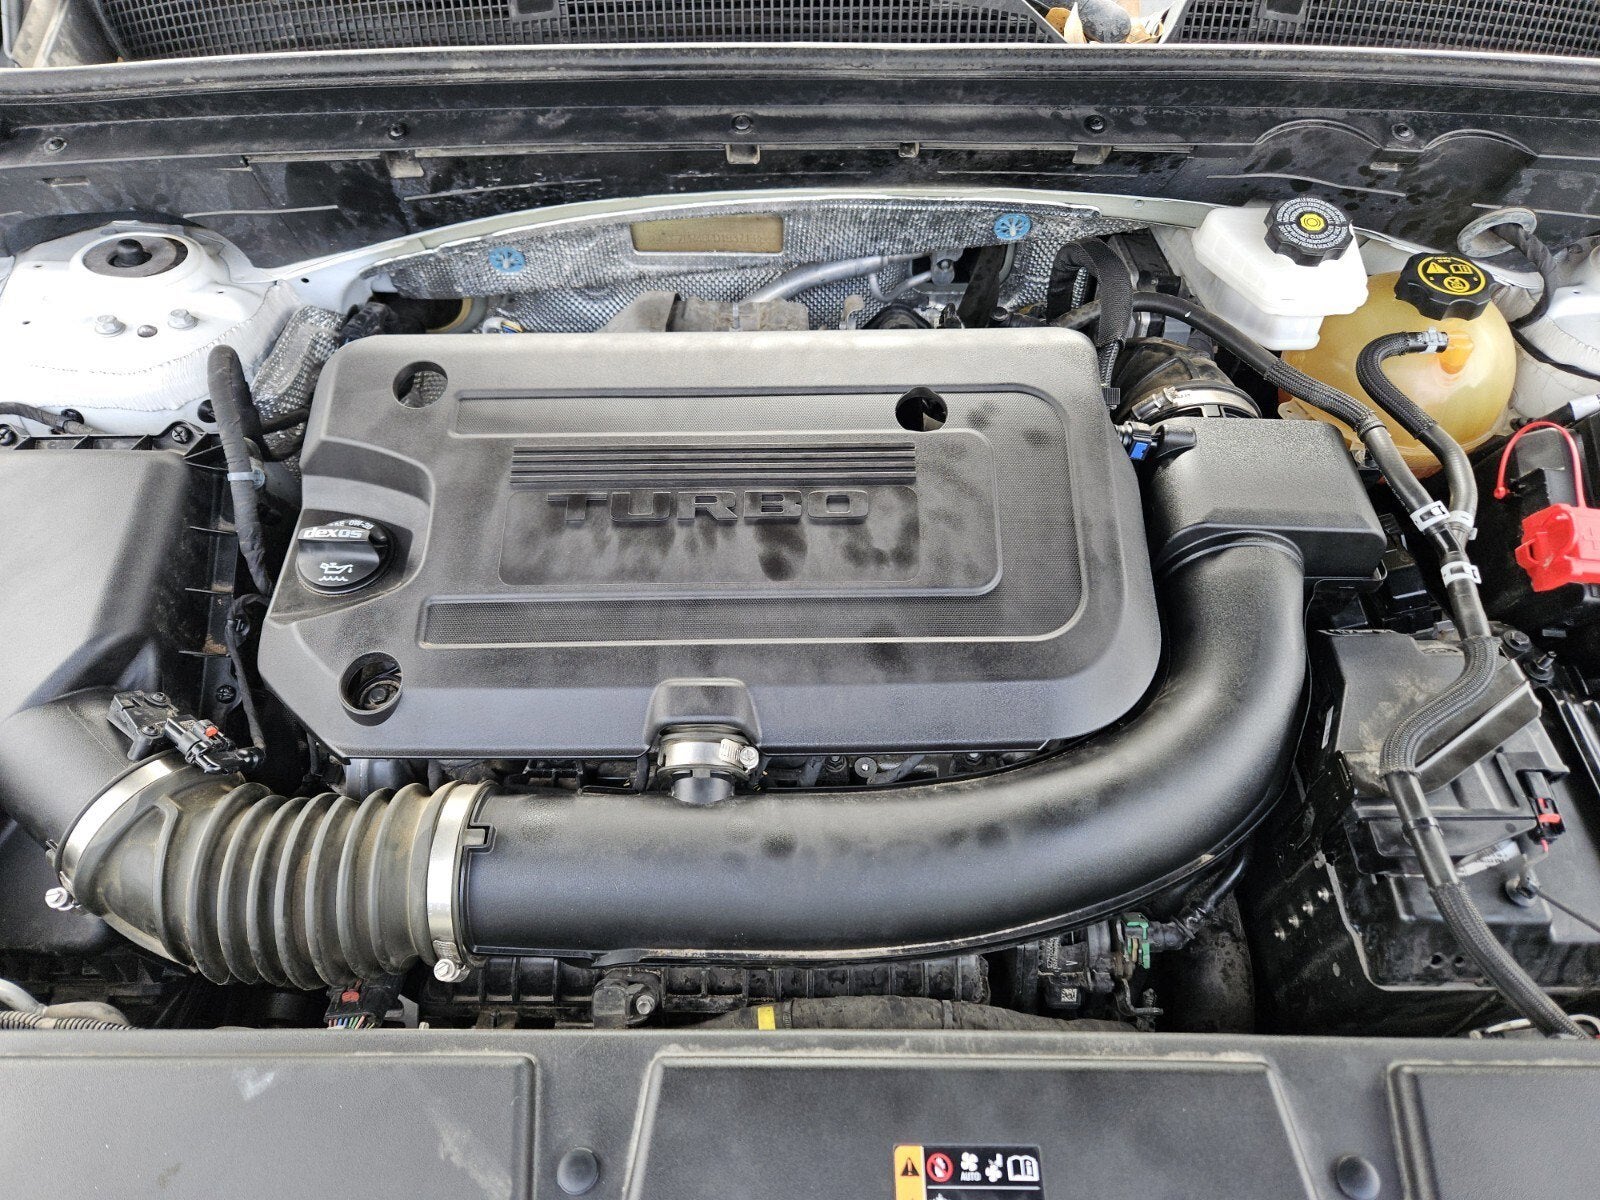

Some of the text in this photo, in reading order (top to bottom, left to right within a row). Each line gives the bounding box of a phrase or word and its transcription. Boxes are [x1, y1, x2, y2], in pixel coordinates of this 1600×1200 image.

[547, 491, 868, 522] TURBO
[303, 527, 362, 538] dexos
[960, 1171, 982, 1182] AUTO
